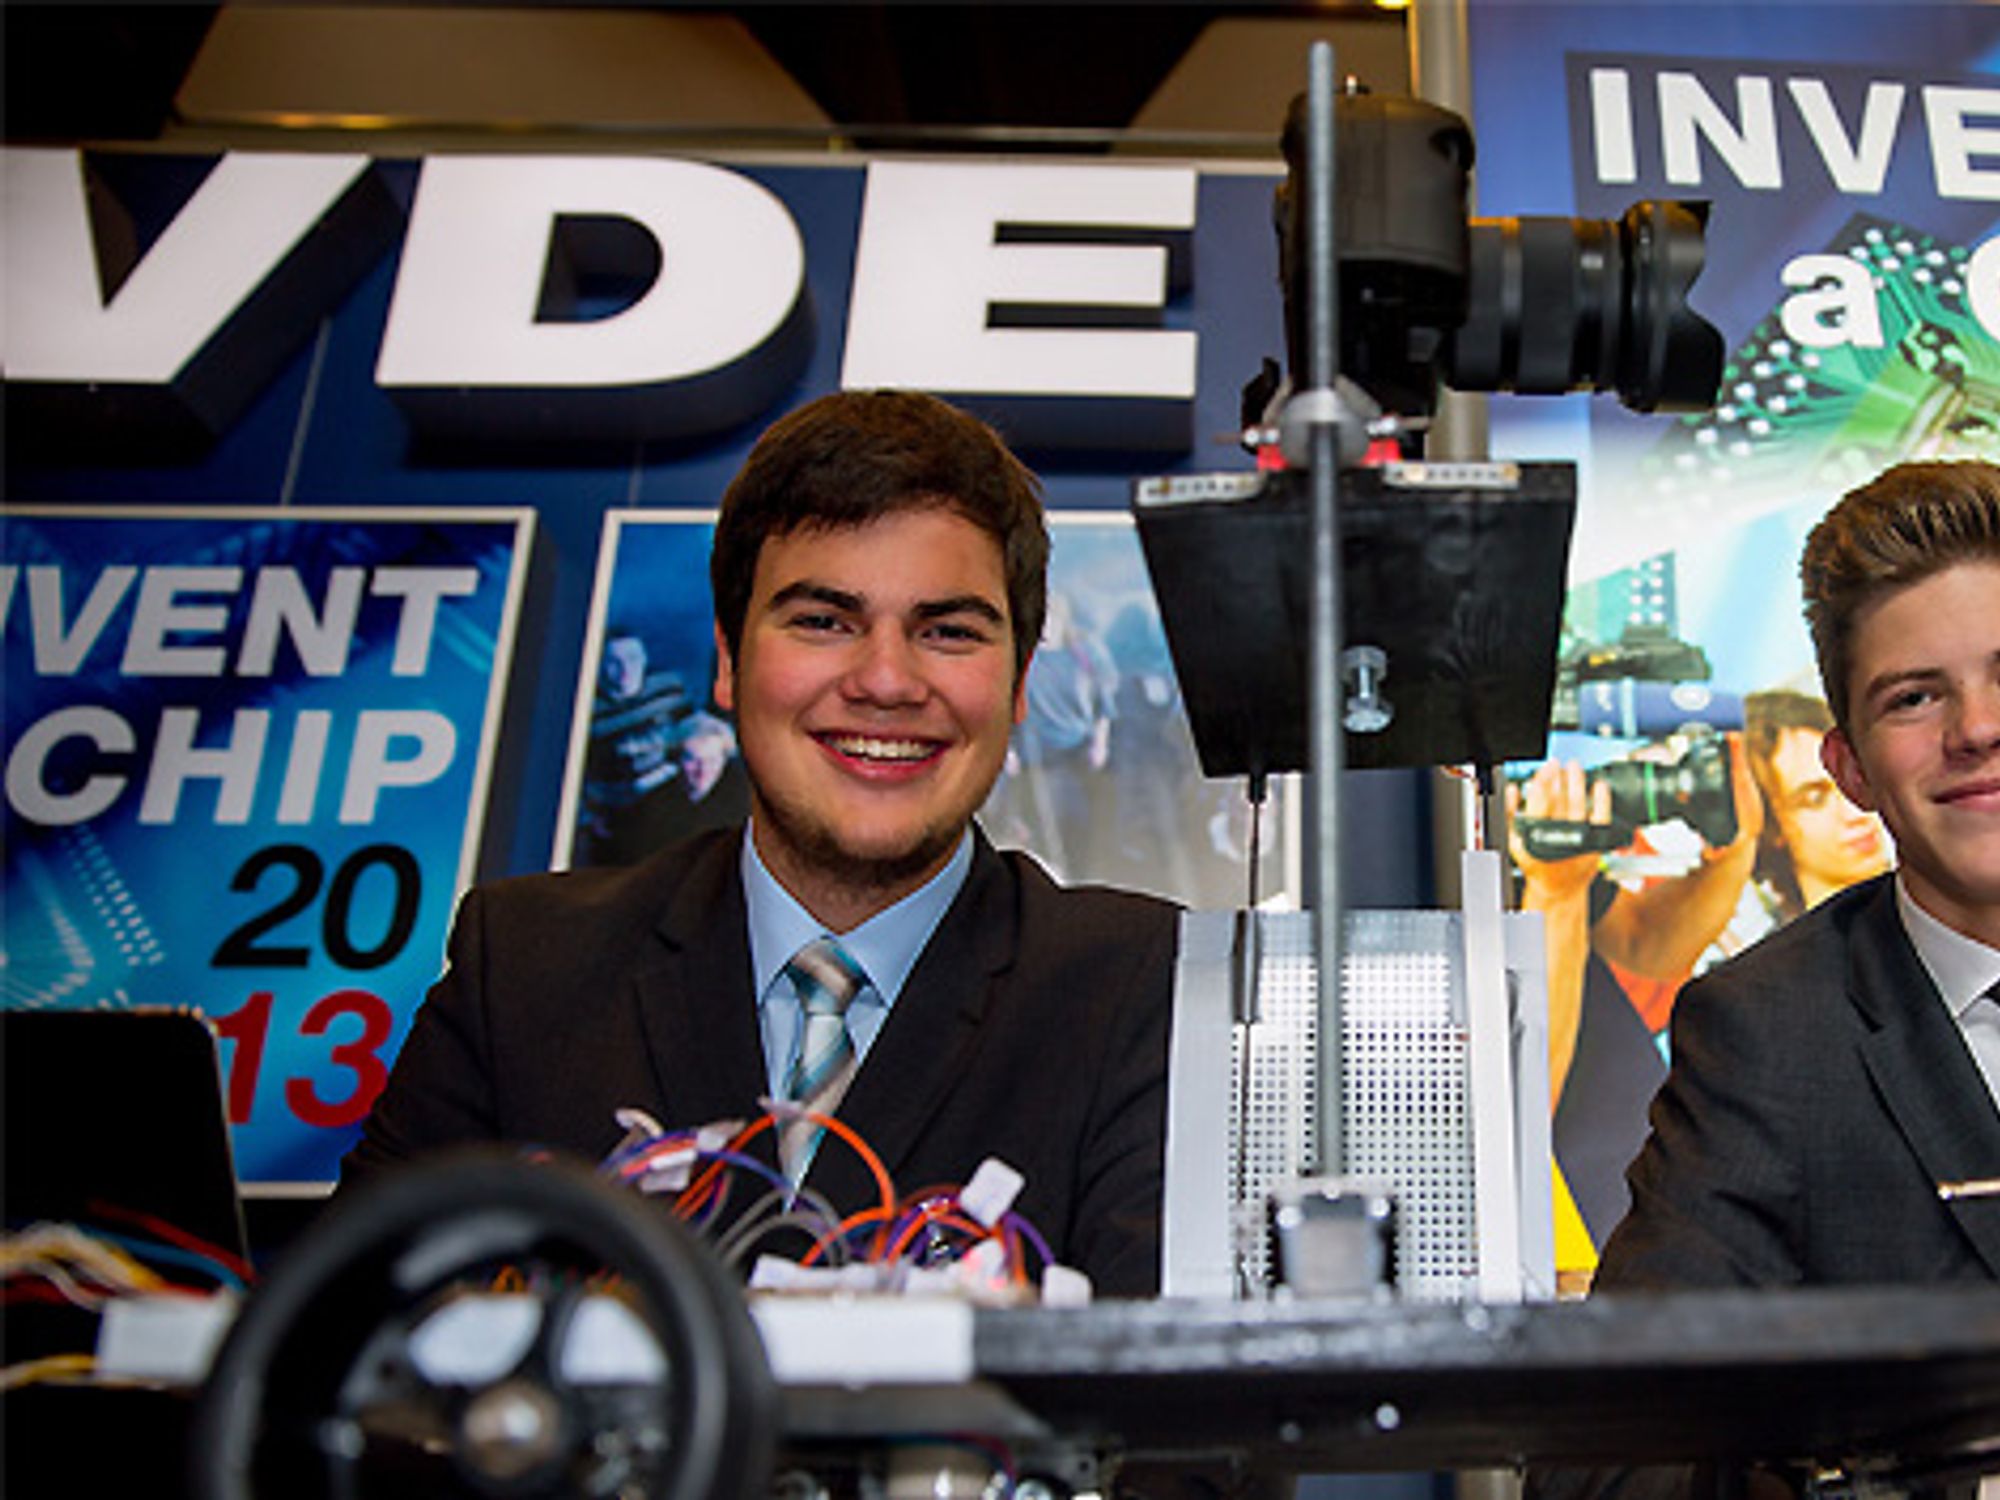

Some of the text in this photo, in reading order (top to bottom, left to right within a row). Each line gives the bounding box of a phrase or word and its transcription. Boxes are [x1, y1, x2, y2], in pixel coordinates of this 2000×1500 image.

[1590, 69, 2000, 199] INVE
[3, 147, 1197, 398] VDE
[1781, 253, 1885, 348] a
[3, 566, 478, 676] VENT
[5, 706, 457, 826] CHIP
[211, 844, 422, 970] 20
[217, 989, 393, 1128] 13
